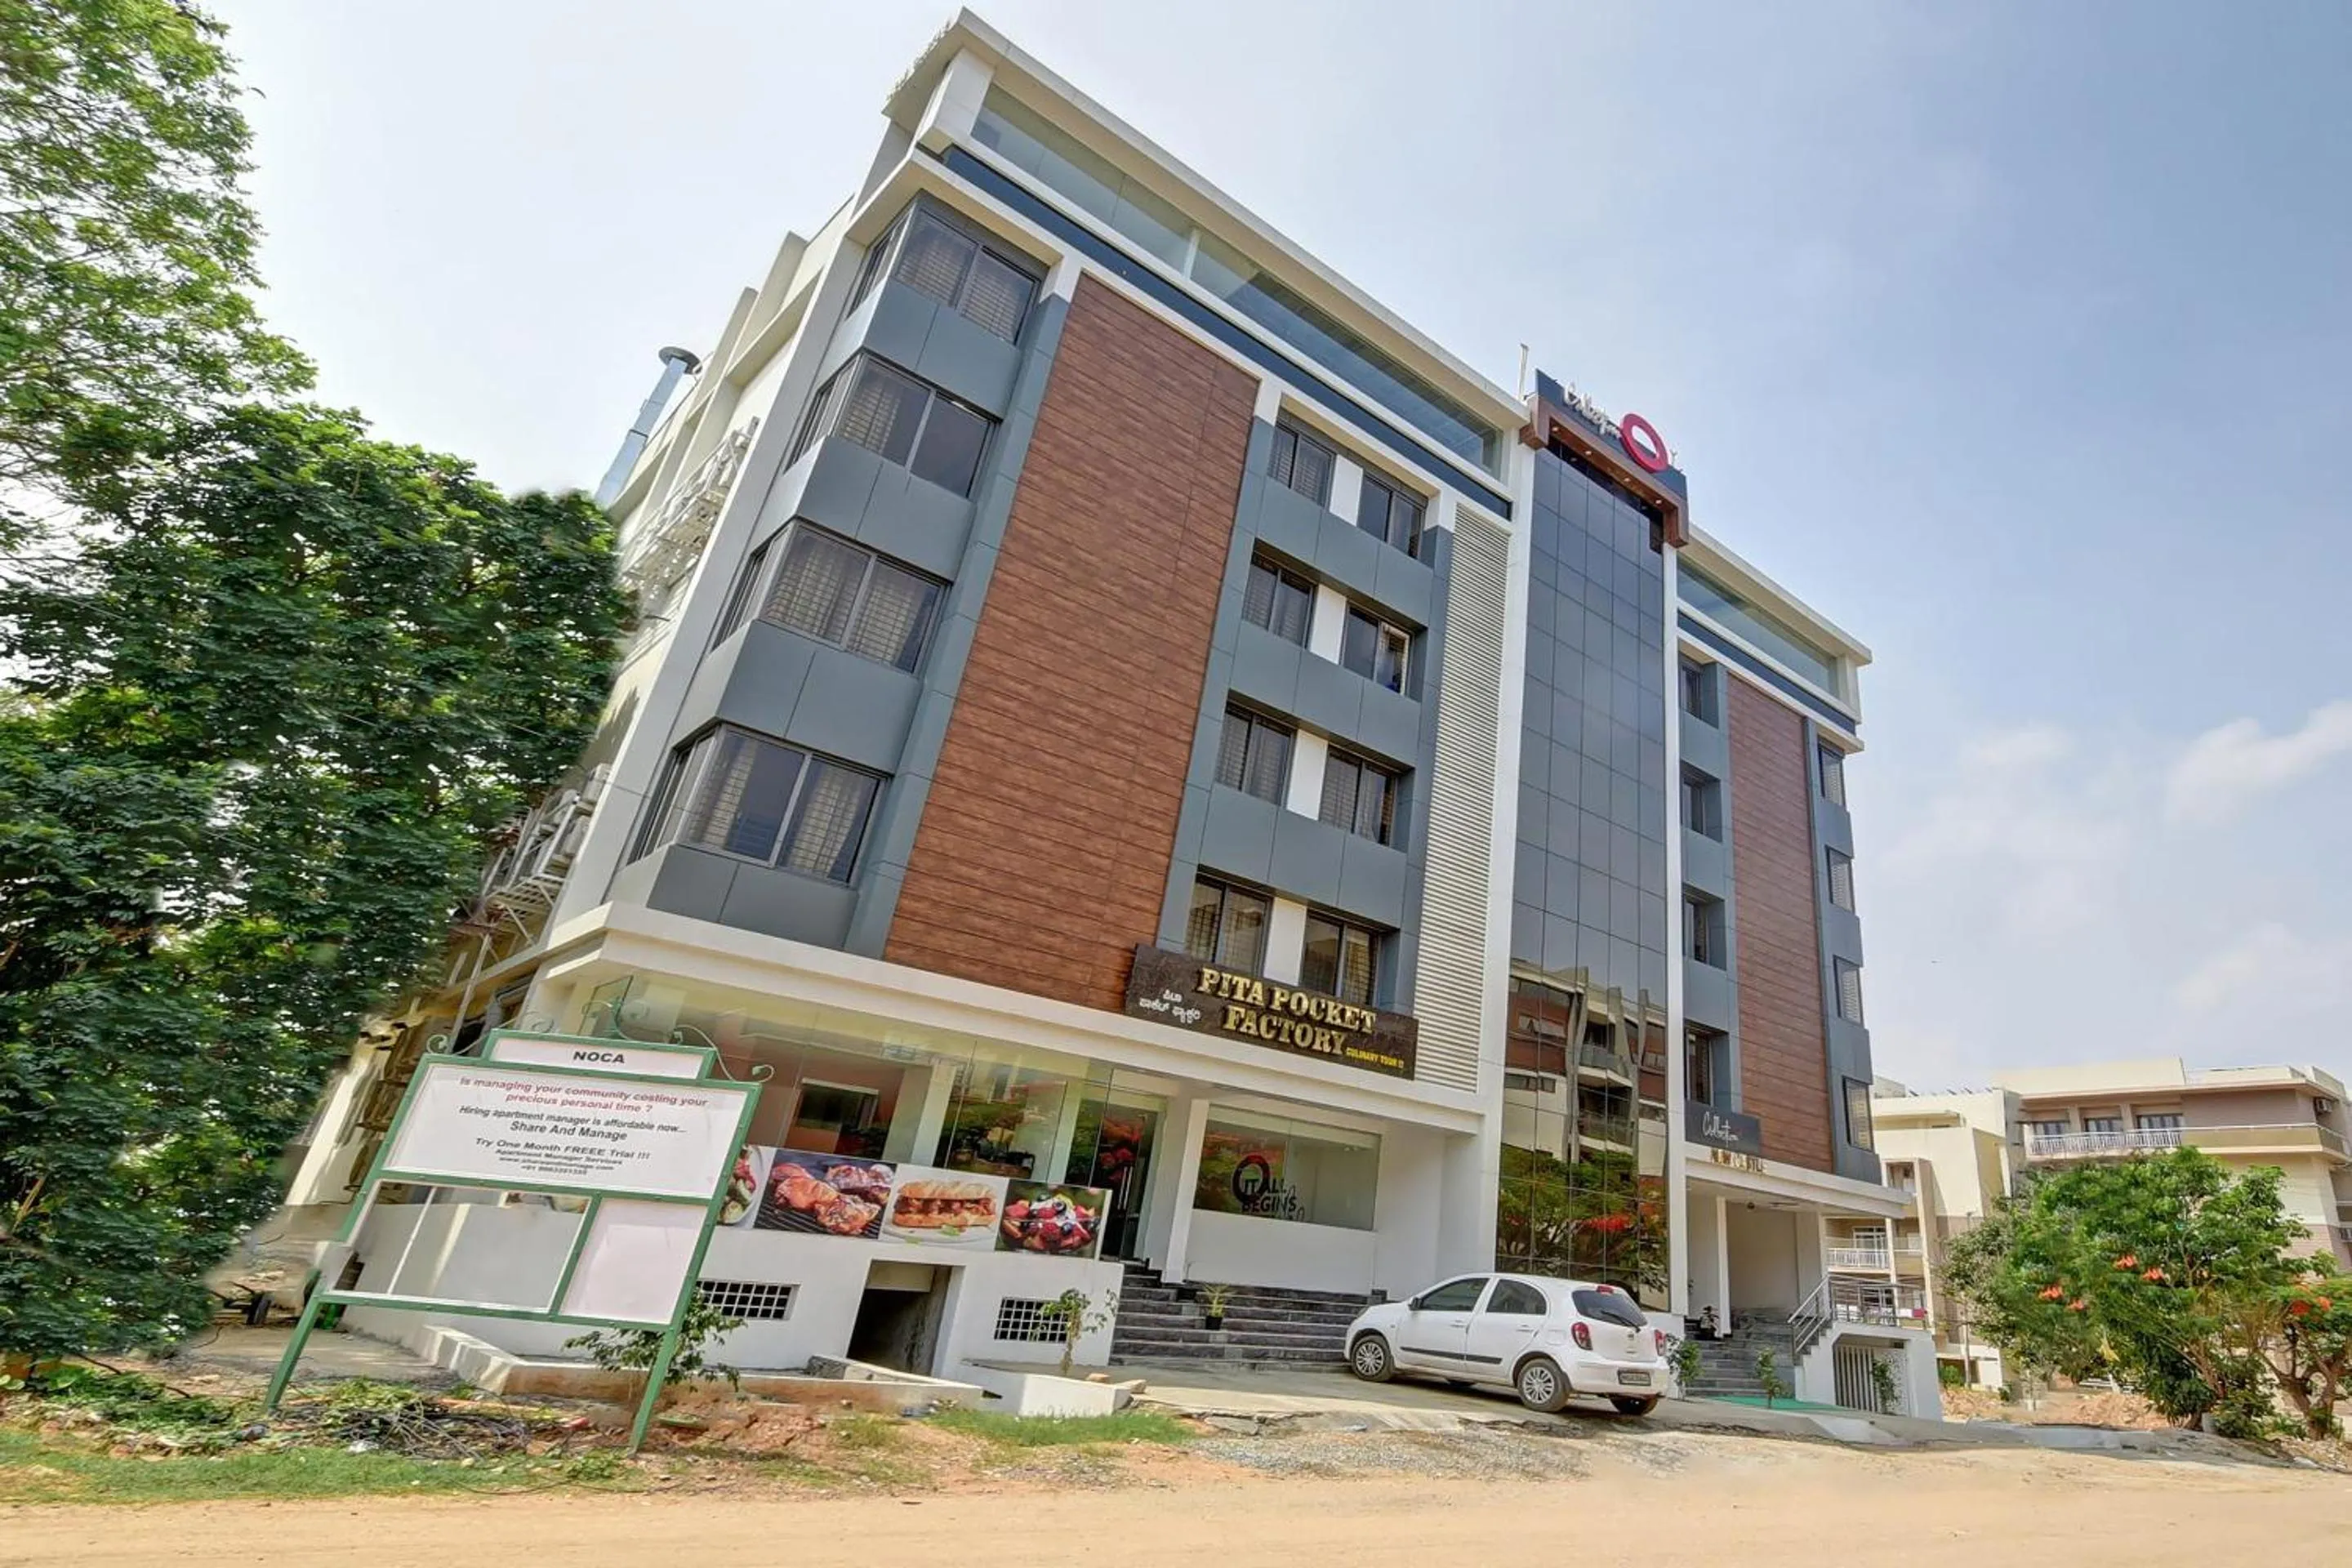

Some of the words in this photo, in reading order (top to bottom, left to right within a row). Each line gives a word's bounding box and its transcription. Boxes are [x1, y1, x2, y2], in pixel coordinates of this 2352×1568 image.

[1196, 967, 1264, 1006] PITA
[1270, 986, 1378, 1034] POCKET
[1223, 1005, 1346, 1055] FACTORY
[573, 1051, 625, 1063] NOCA
[474, 1079, 532, 1092] managing
[535, 1085, 561, 1094] your
[564, 1087, 631, 1101] community
[634, 1093, 677, 1104] costing
[679, 1098, 708, 1107] your
[506, 1094, 558, 1104] precious
[560, 1099, 613, 1110] personal
[616, 1102, 641, 1111] time
[459, 1105, 490, 1117] Hiring
[492, 1109, 544, 1121] apartment
[546, 1114, 590, 1125] manager
[604, 1118, 654, 1130] affordable
[510, 1120, 547, 1133] Share
[550, 1125, 576, 1136] And
[578, 1126, 627, 1142] Manage
[476, 1138, 493, 1147] Try
[497, 1139, 521, 1147] One
[523, 1142, 561, 1152] Month
[610, 1148, 635, 1158] Trial
